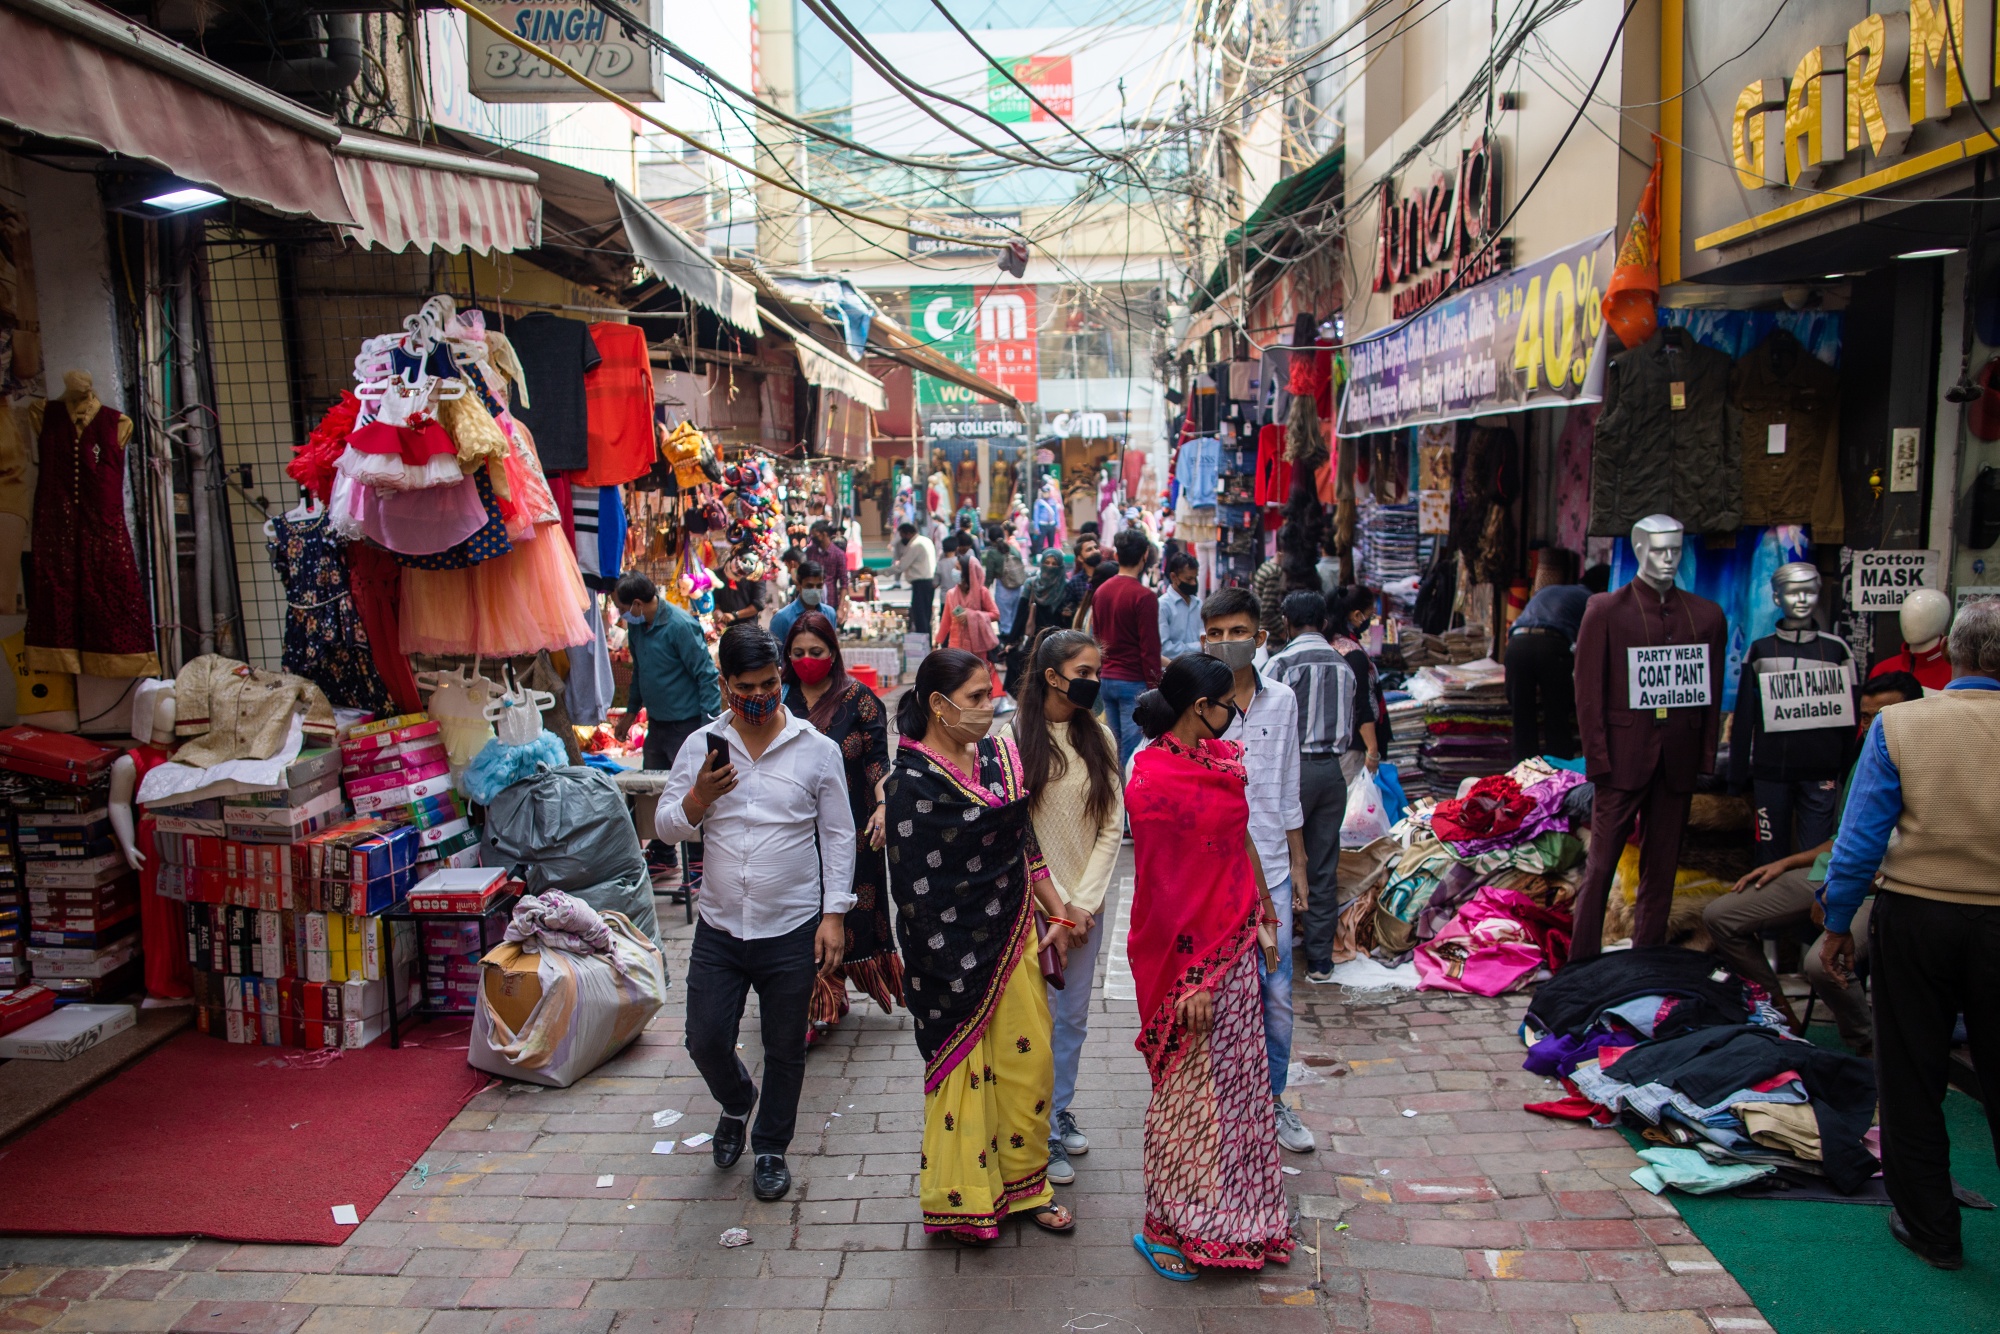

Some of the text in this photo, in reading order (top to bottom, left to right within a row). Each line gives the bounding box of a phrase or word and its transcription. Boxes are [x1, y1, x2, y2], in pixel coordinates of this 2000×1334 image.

[513, 8, 607, 42] SINGH
[485, 43, 633, 78] BAND
[1732, 0, 2000, 190] GARM
[1460, 238, 1502, 288] HOUSE
[1514, 251, 1601, 391] 40%
[930, 420, 1023, 436] PARI COLLECTION
[1861, 553, 1926, 566] Cotton
[1859, 568, 1925, 587] MASK
[1637, 647, 1703, 662] PARTY WEAR
[1638, 663, 1704, 688] COAT PANT
[1768, 669, 1846, 700] KURTA PAJAMA
[1639, 688, 1706, 706] Available
[1774, 701, 1843, 720] Available
[1757, 806, 1774, 842] USA
[333, 883, 342, 907] BEST
[455, 902, 477, 911] Sumit
[201, 926, 210, 950] RACE
